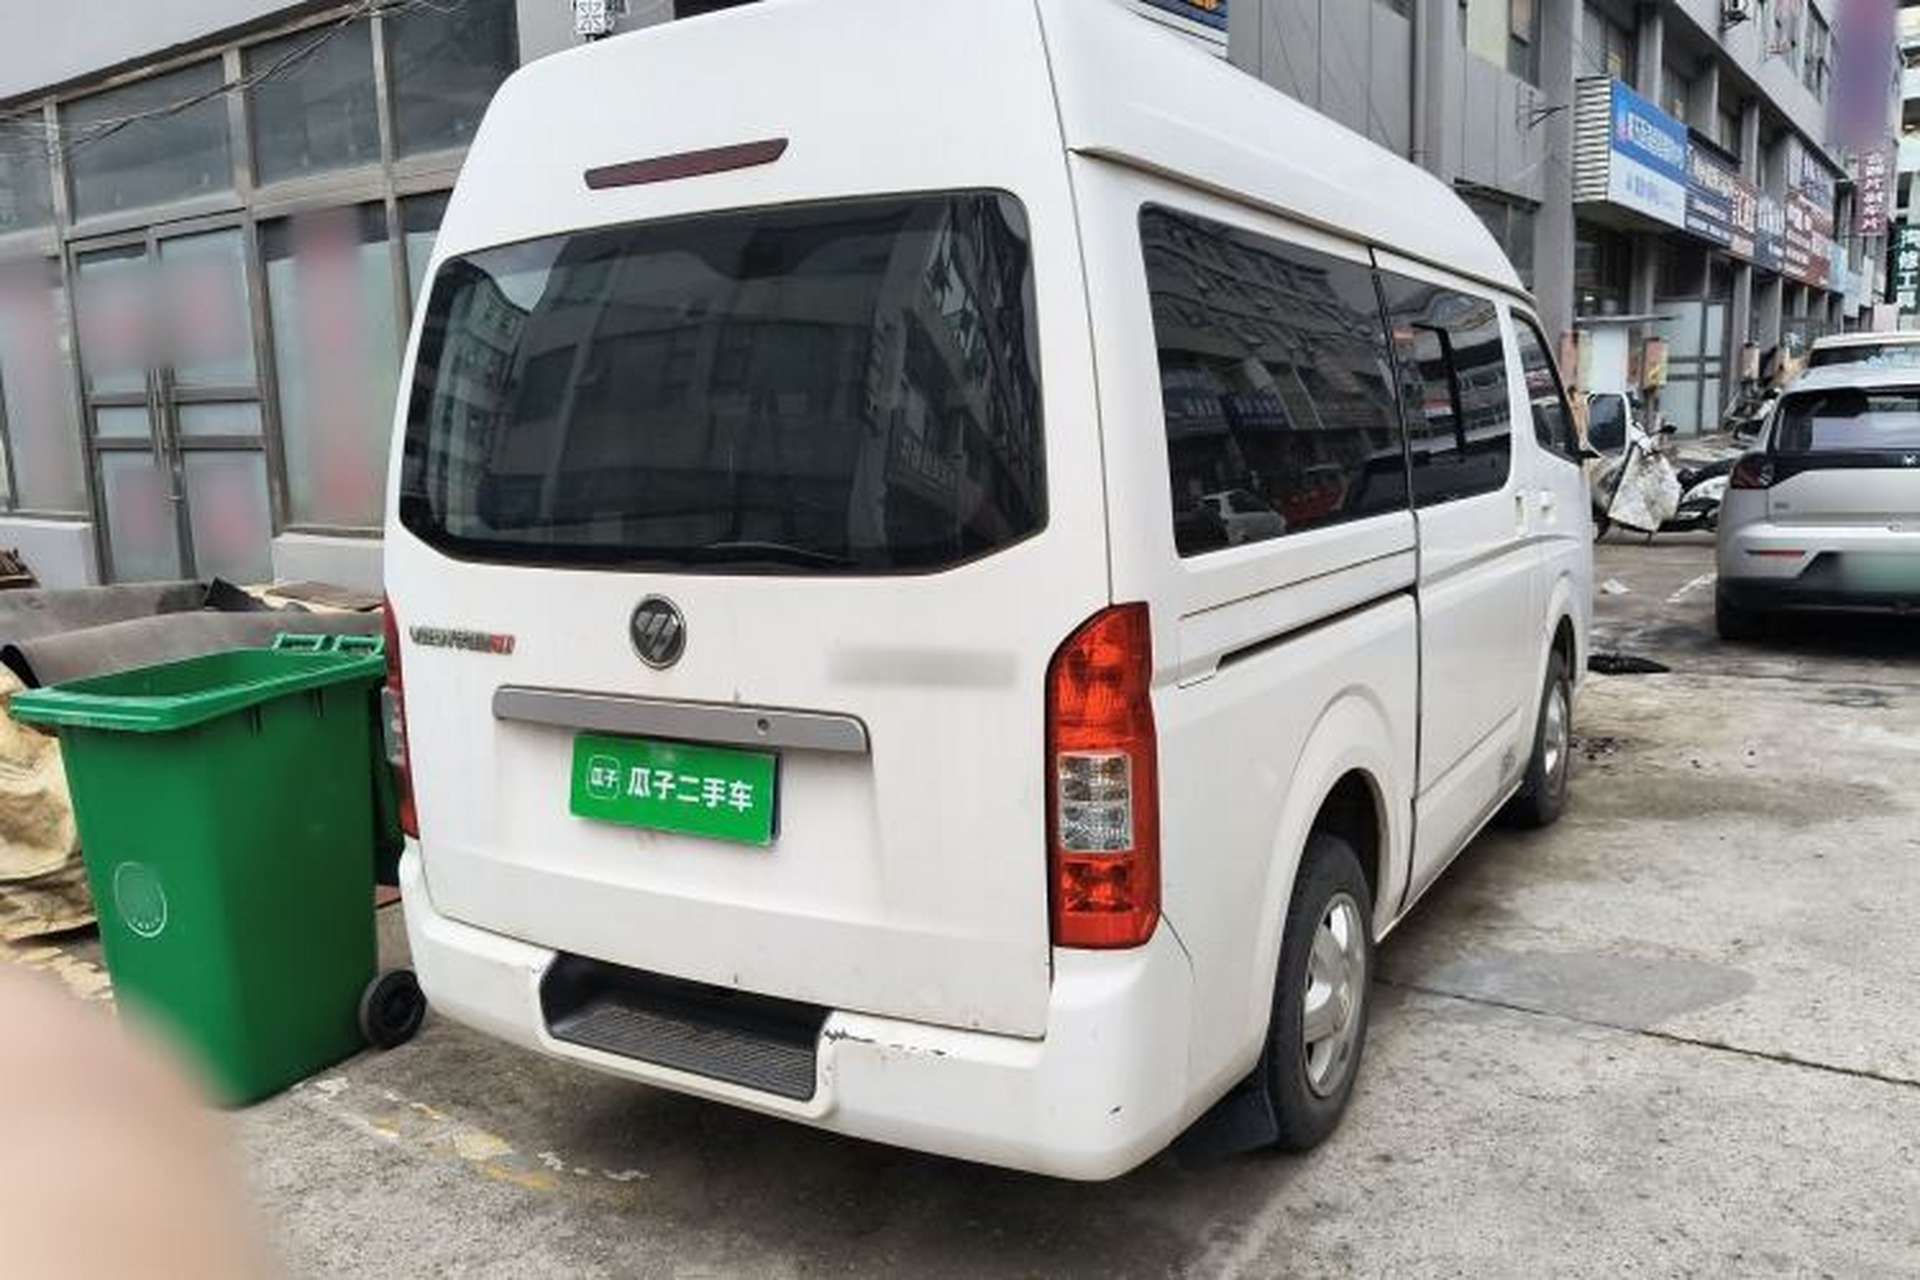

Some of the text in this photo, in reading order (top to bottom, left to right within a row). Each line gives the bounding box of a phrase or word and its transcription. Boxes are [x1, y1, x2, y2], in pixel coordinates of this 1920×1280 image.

[627, 767, 753, 812] 瓜子二手车
